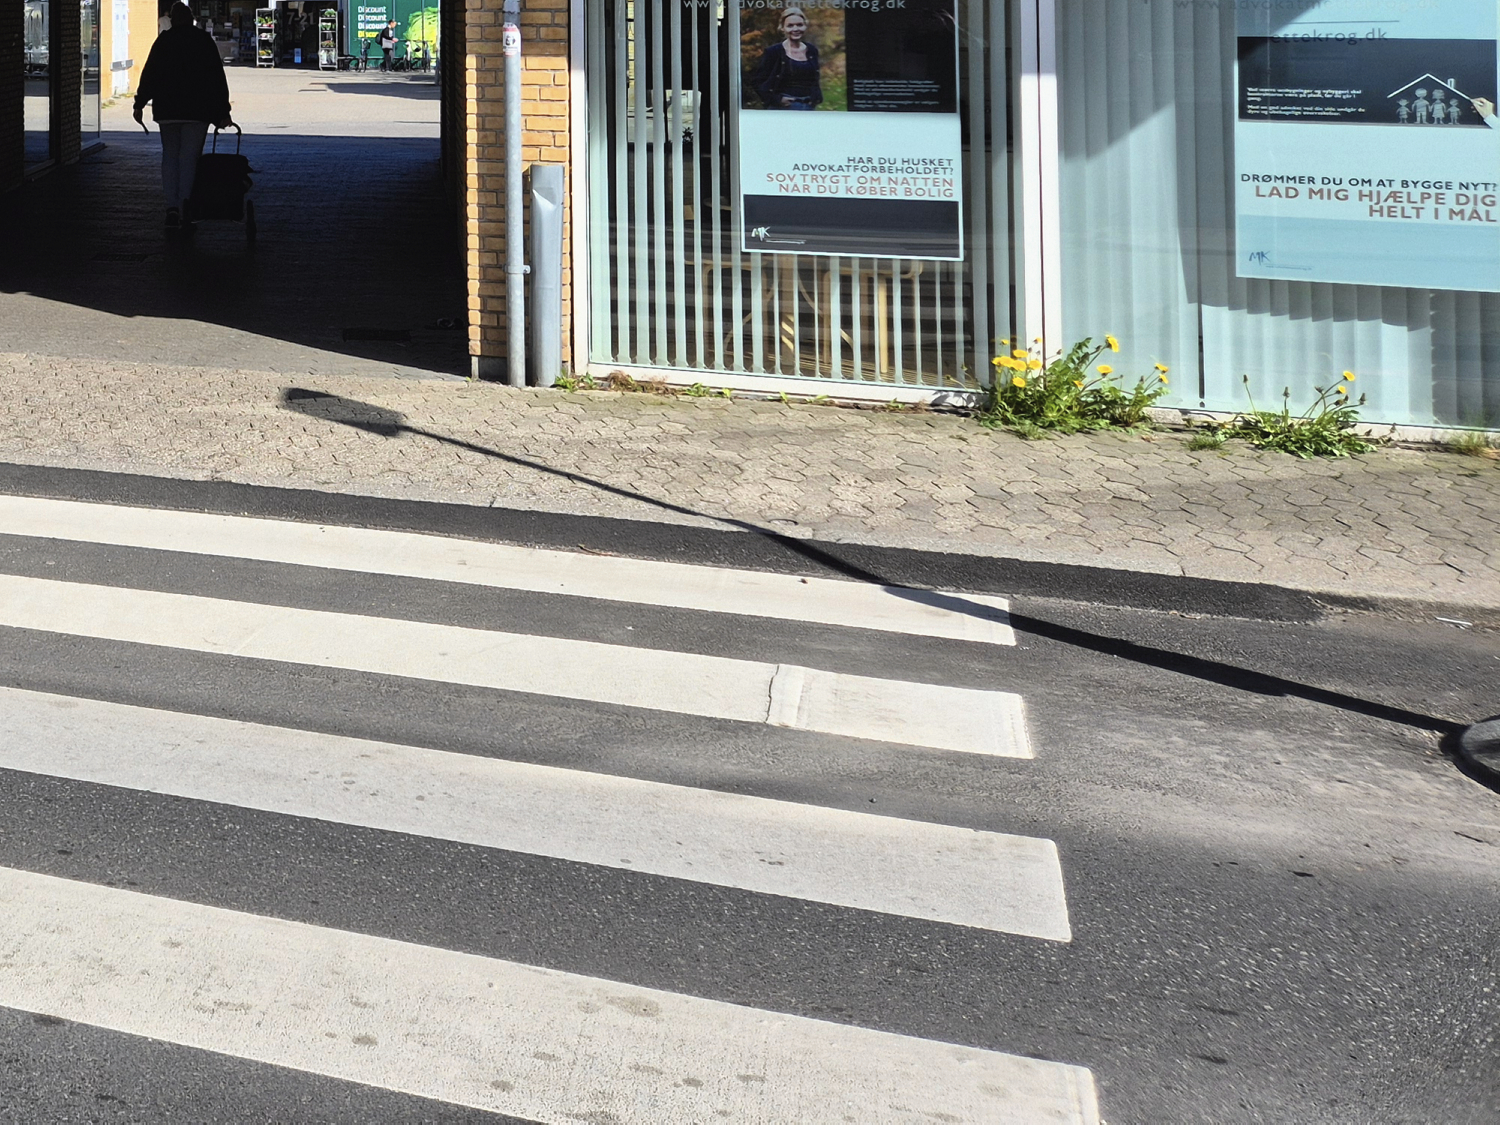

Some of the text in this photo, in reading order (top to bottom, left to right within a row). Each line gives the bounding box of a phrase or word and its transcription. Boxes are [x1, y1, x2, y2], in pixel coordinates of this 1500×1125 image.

[287, 12, 316, 25] 7-21
[847, 156, 954, 167] HAR DU HUSKET
[793, 163, 954, 175] ADVOKATFORBEHOLDET?
[766, 172, 953, 187] SOV TRYGT OM NATTEN
[1241, 174, 1498, 192] DRØMMER DU OM AT BYGGE NYT?
[817, 185, 839, 194] DU
[846, 185, 898, 196] KØBER
[905, 187, 954, 198] BOLIG
[1255, 185, 1496, 207] LAD MIG HJÆLPE DIG
[1369, 204, 1497, 222] HELT I MÅL
